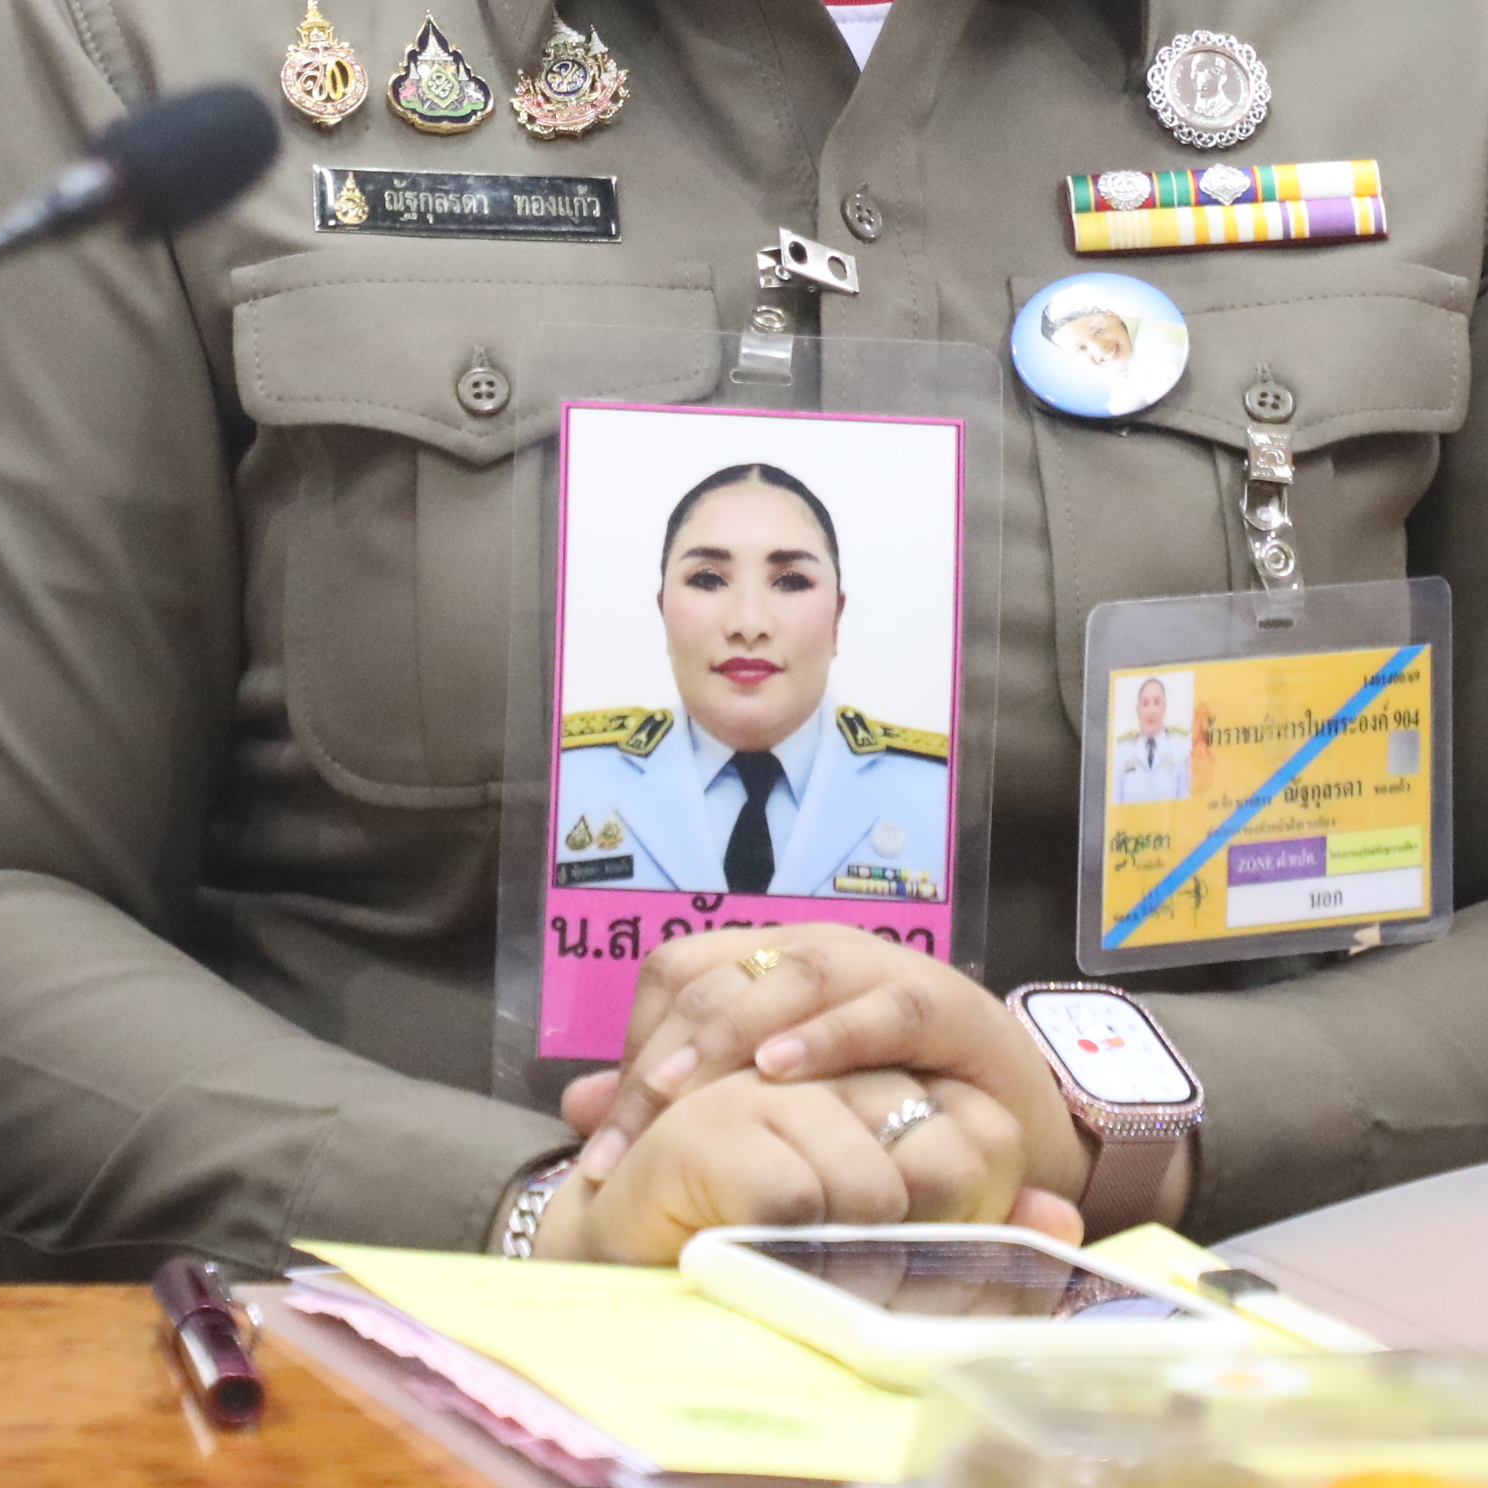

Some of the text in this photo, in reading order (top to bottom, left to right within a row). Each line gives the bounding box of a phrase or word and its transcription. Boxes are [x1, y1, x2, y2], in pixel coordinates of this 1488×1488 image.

[384, 179, 601, 224] ณัฐกุลรดา ทองแก้ว
[1393, 710, 1421, 730] 904
[1237, 856, 1273, 874] ZONE
